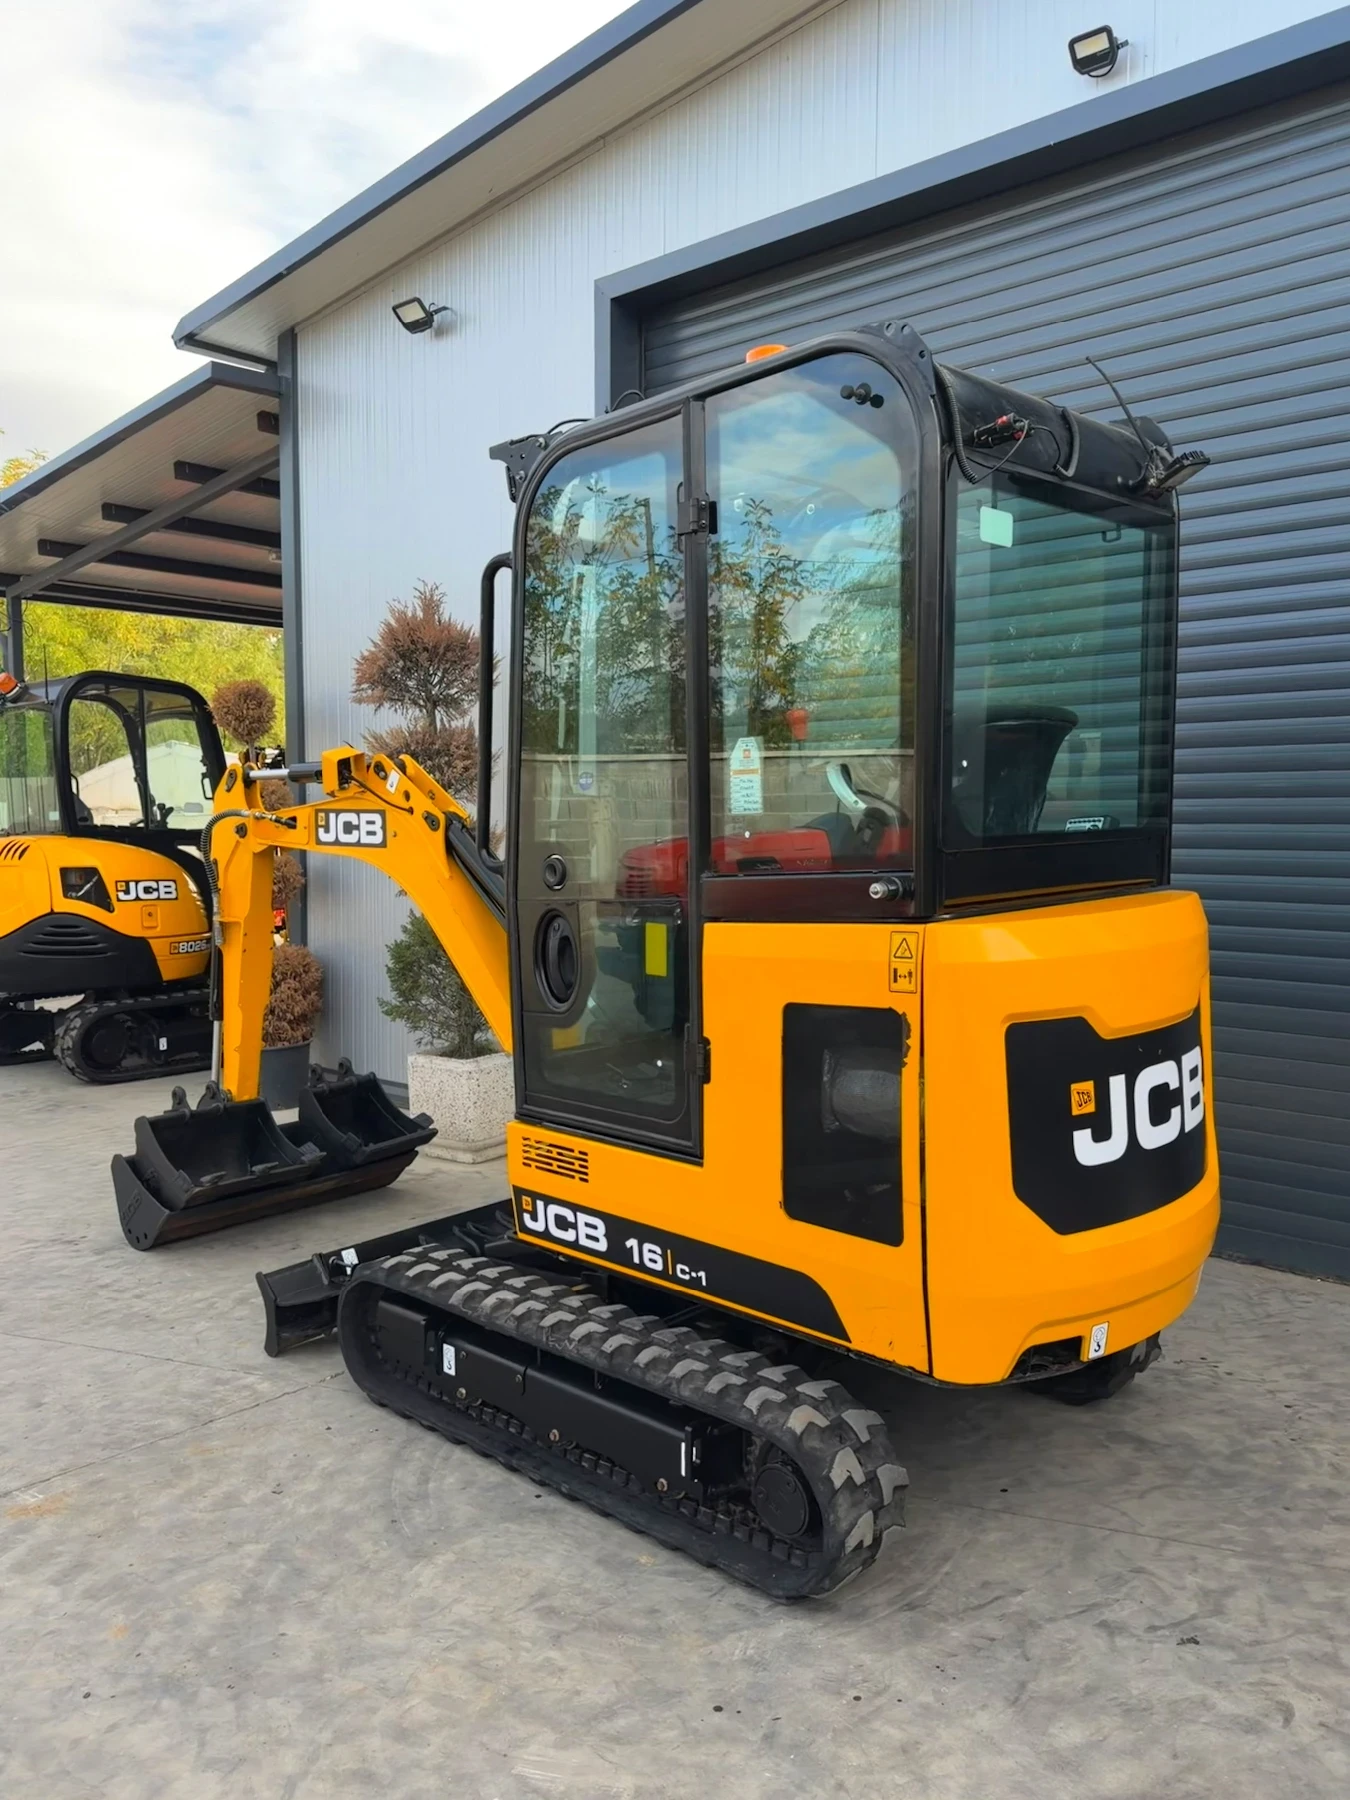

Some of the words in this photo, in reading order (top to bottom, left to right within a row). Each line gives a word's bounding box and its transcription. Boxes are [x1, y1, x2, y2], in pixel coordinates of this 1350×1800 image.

[318, 812, 383, 844] JCB
[117, 881, 177, 900] JCB
[1073, 1046, 1204, 1166] JCB
[1077, 1091, 1092, 1107] JCB
[523, 1199, 608, 1252] JCB
